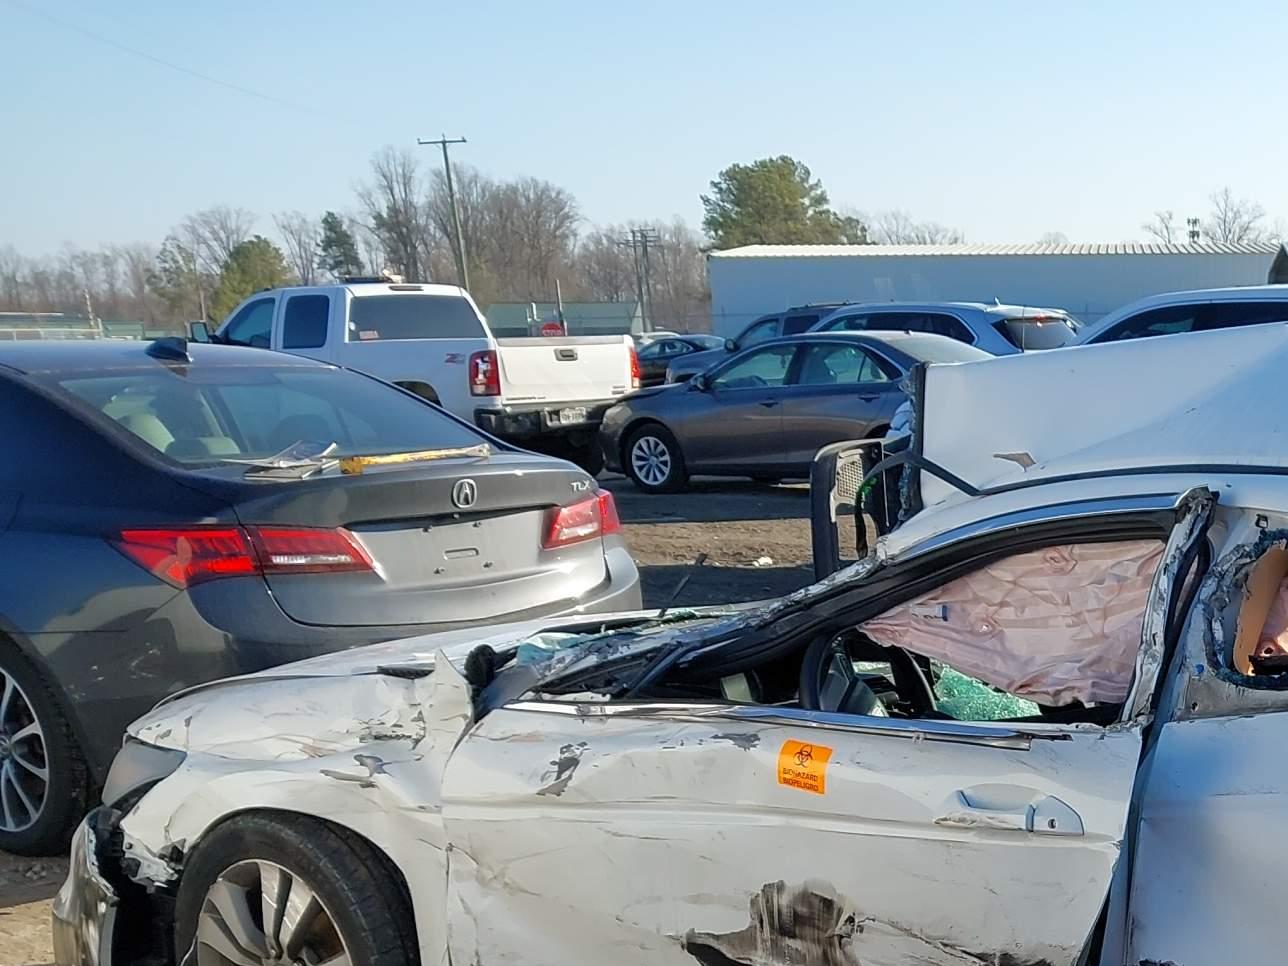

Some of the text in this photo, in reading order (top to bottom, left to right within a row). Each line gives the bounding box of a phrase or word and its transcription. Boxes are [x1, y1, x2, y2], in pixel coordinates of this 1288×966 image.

[570, 480, 591, 492] TLX
[783, 768, 818, 782] BIOHAZARD
[783, 777, 819, 792] BIOPELIGRO
